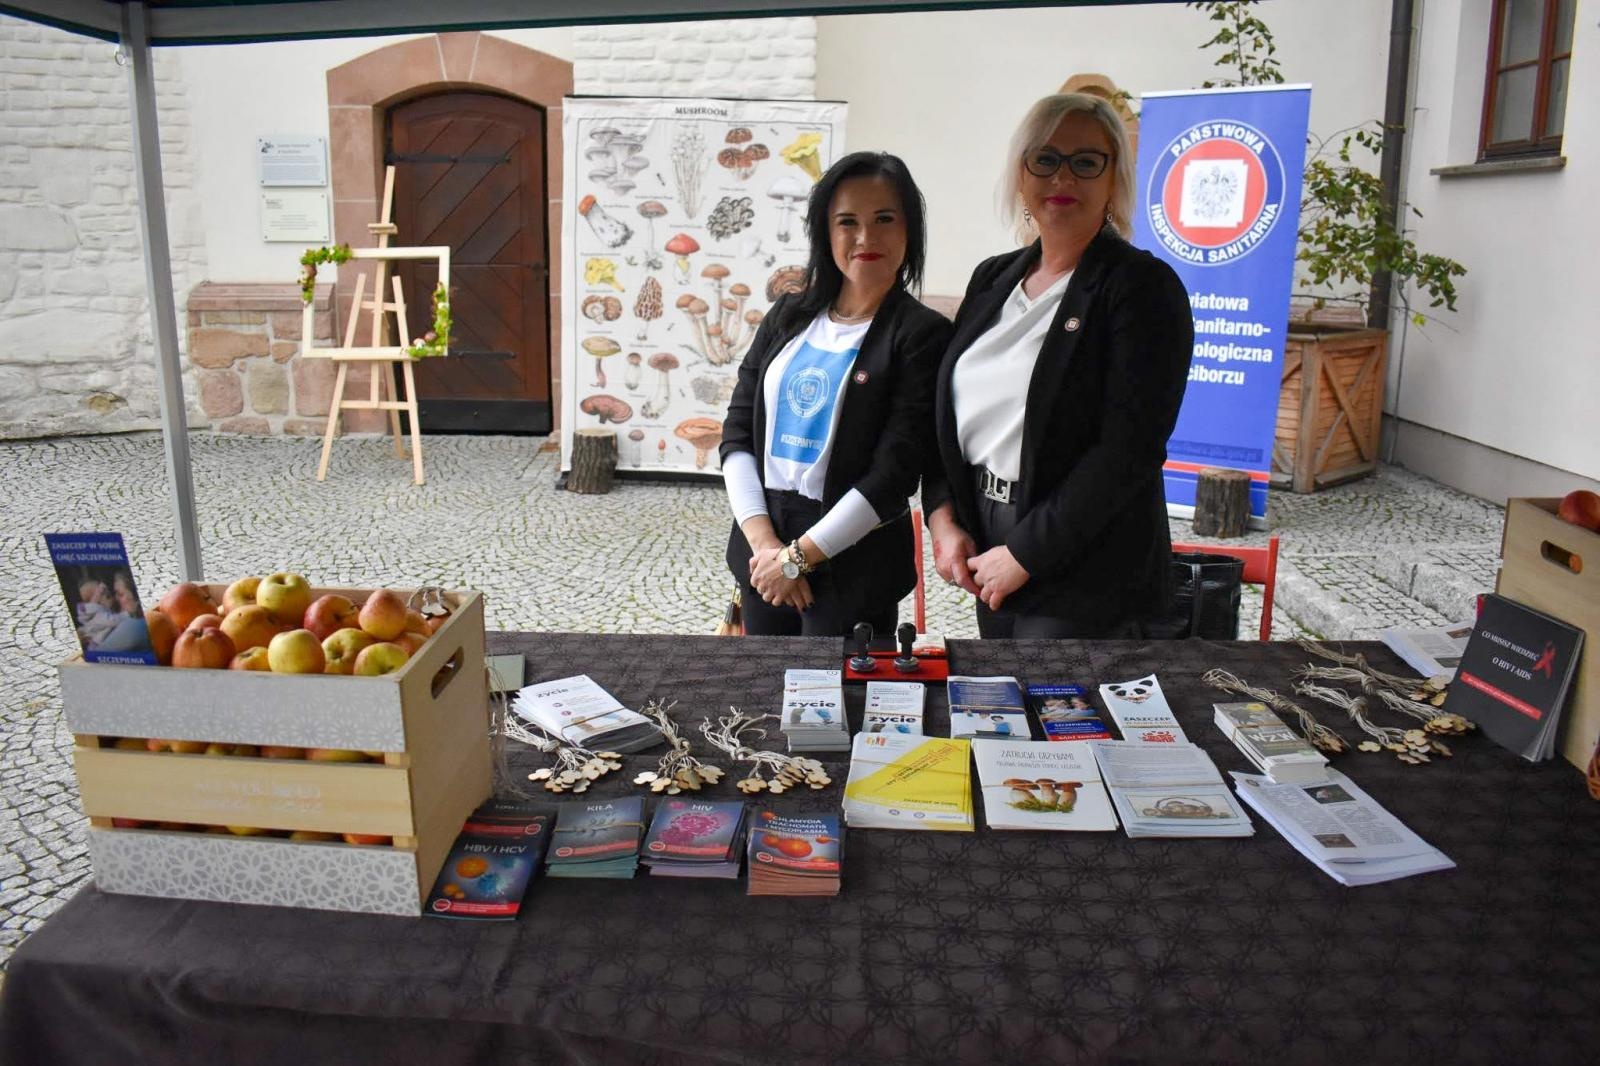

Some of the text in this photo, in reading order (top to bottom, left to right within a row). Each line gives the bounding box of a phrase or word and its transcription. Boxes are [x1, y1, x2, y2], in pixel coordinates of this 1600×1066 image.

[675, 106, 728, 117] MUSHROOM
[1170, 124, 1266, 157] PAŃSTWOWA
[1151, 203, 1279, 263] INSPEKCJA SANITARNA
[1192, 317, 1271, 337] anitarno-
[1193, 341, 1273, 363] ologiczna
[1514, 668, 1533, 680] AIDS
[868, 715, 917, 724] życie
[1247, 731, 1297, 742] WZW
[691, 804, 713, 812] HIV
[768, 820, 827, 829] TRACHOMATIS
[772, 816, 822, 824] CHLAMYDIA
[770, 825, 829, 834] MYCOPLASMA
[464, 843, 491, 853] HBV
[500, 845, 528, 853] HCV
